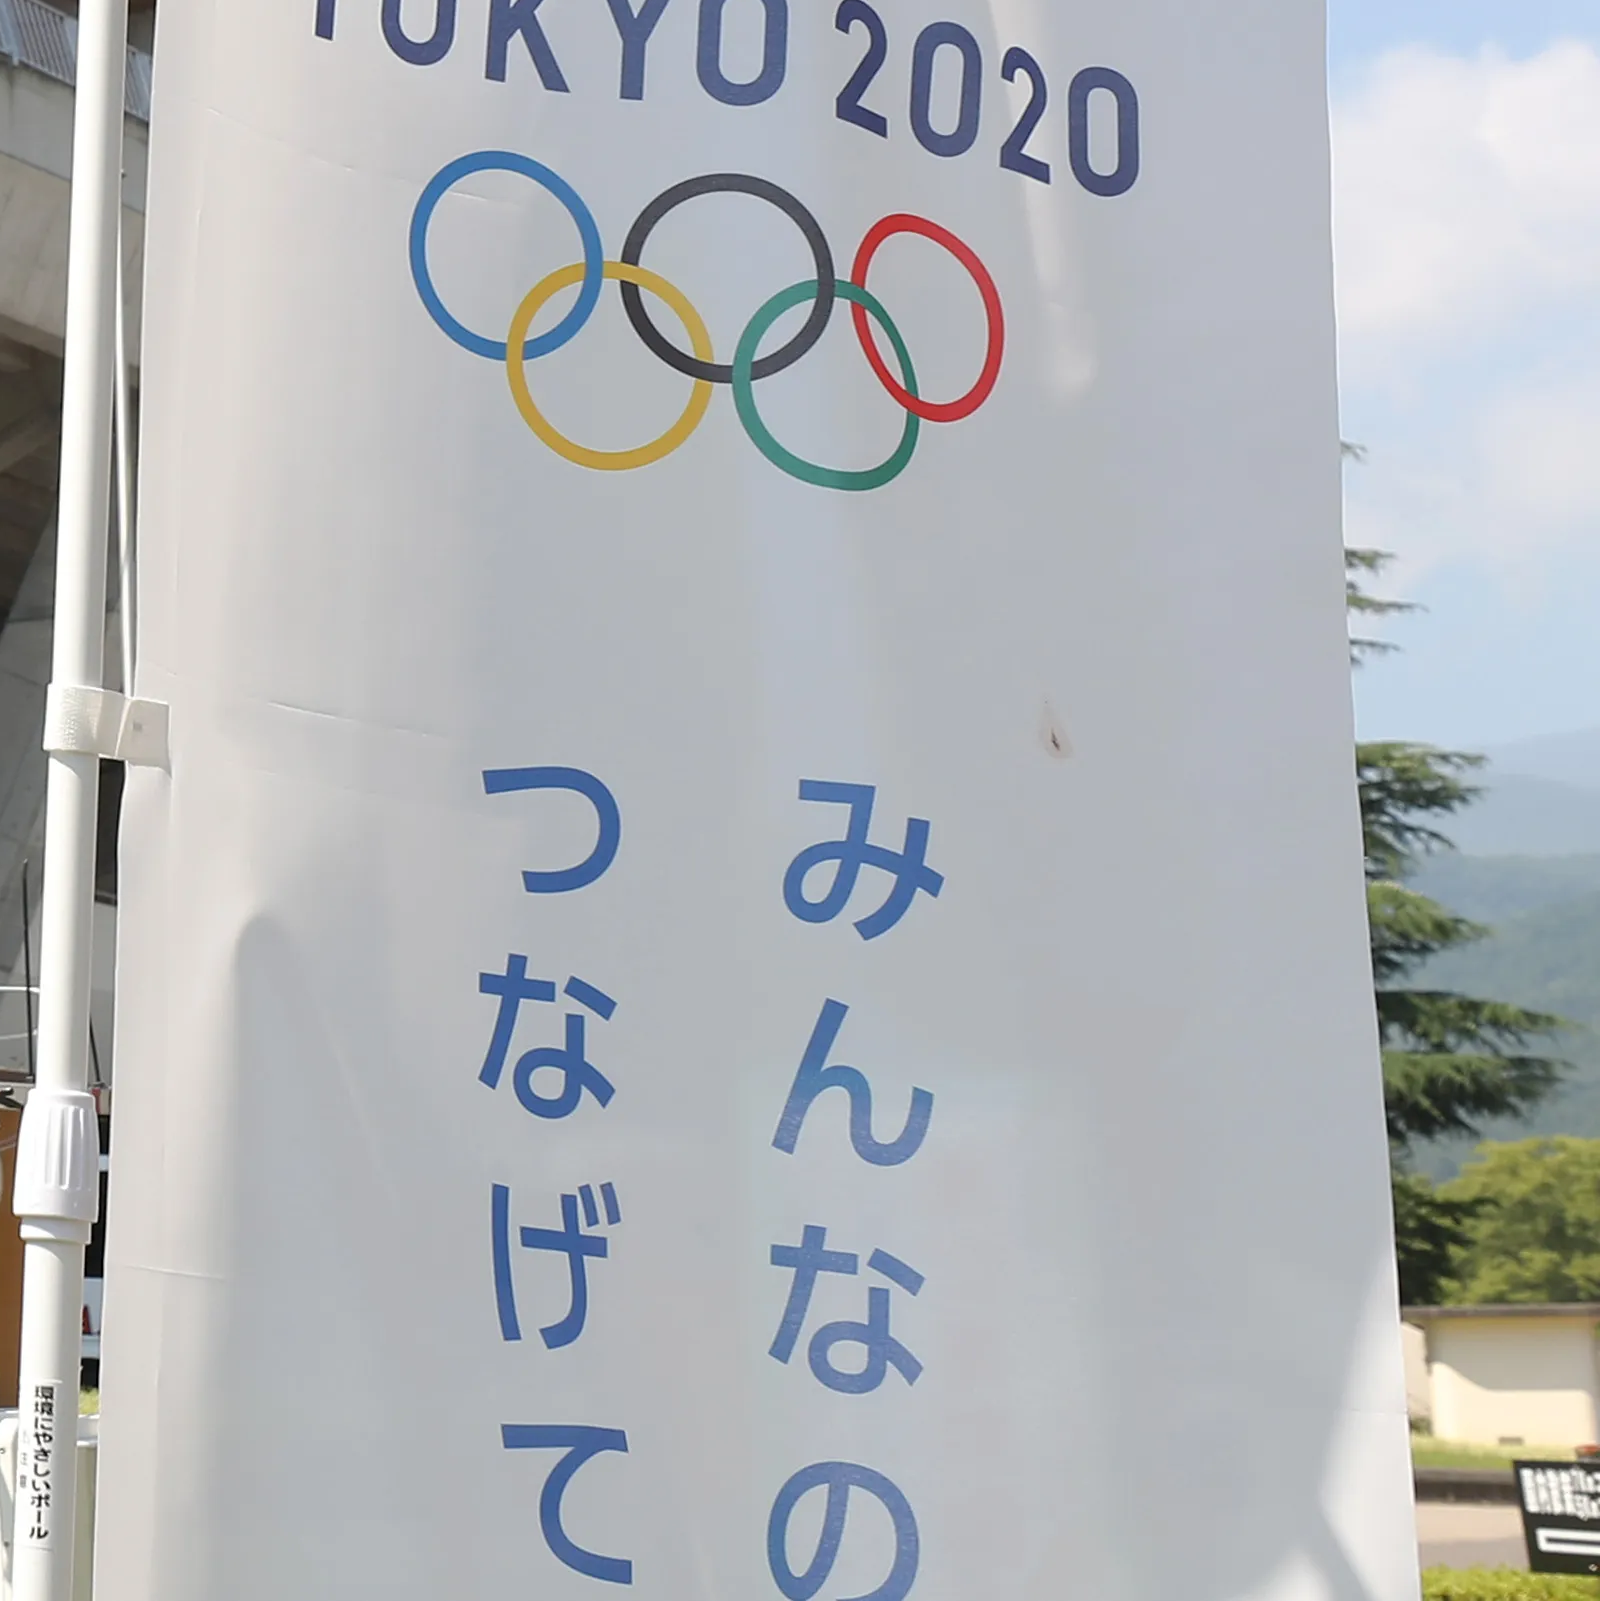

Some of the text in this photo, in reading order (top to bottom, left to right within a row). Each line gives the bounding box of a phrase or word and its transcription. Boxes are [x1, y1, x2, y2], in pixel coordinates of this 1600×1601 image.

[29, 1385, 54, 1539] 環境にやさしいポール
[478, 766, 633, 1585] つなげて
[767, 778, 945, 1601] みんなの
